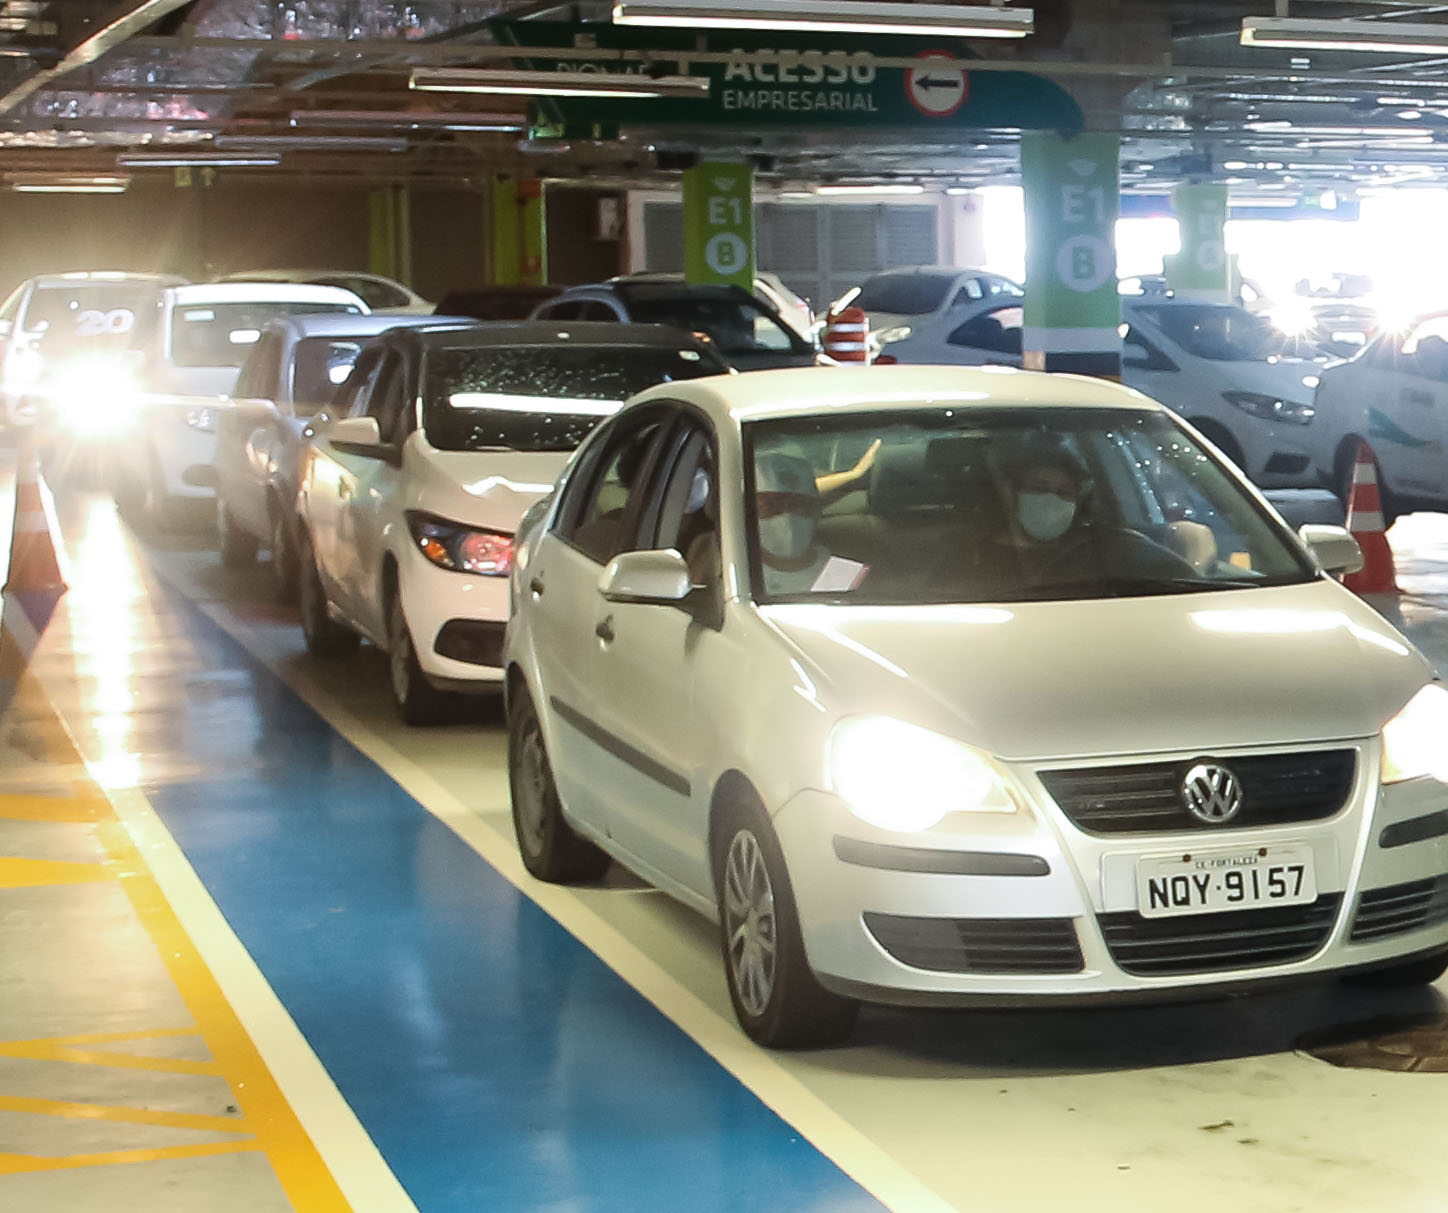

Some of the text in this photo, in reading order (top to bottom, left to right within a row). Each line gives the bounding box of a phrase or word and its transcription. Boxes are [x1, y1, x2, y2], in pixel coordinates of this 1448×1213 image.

[724, 48, 877, 85] ACESSO
[722, 89, 879, 112] EMPRESARIAL
[709, 197, 742, 224] E1
[1062, 184, 1104, 222] E1
